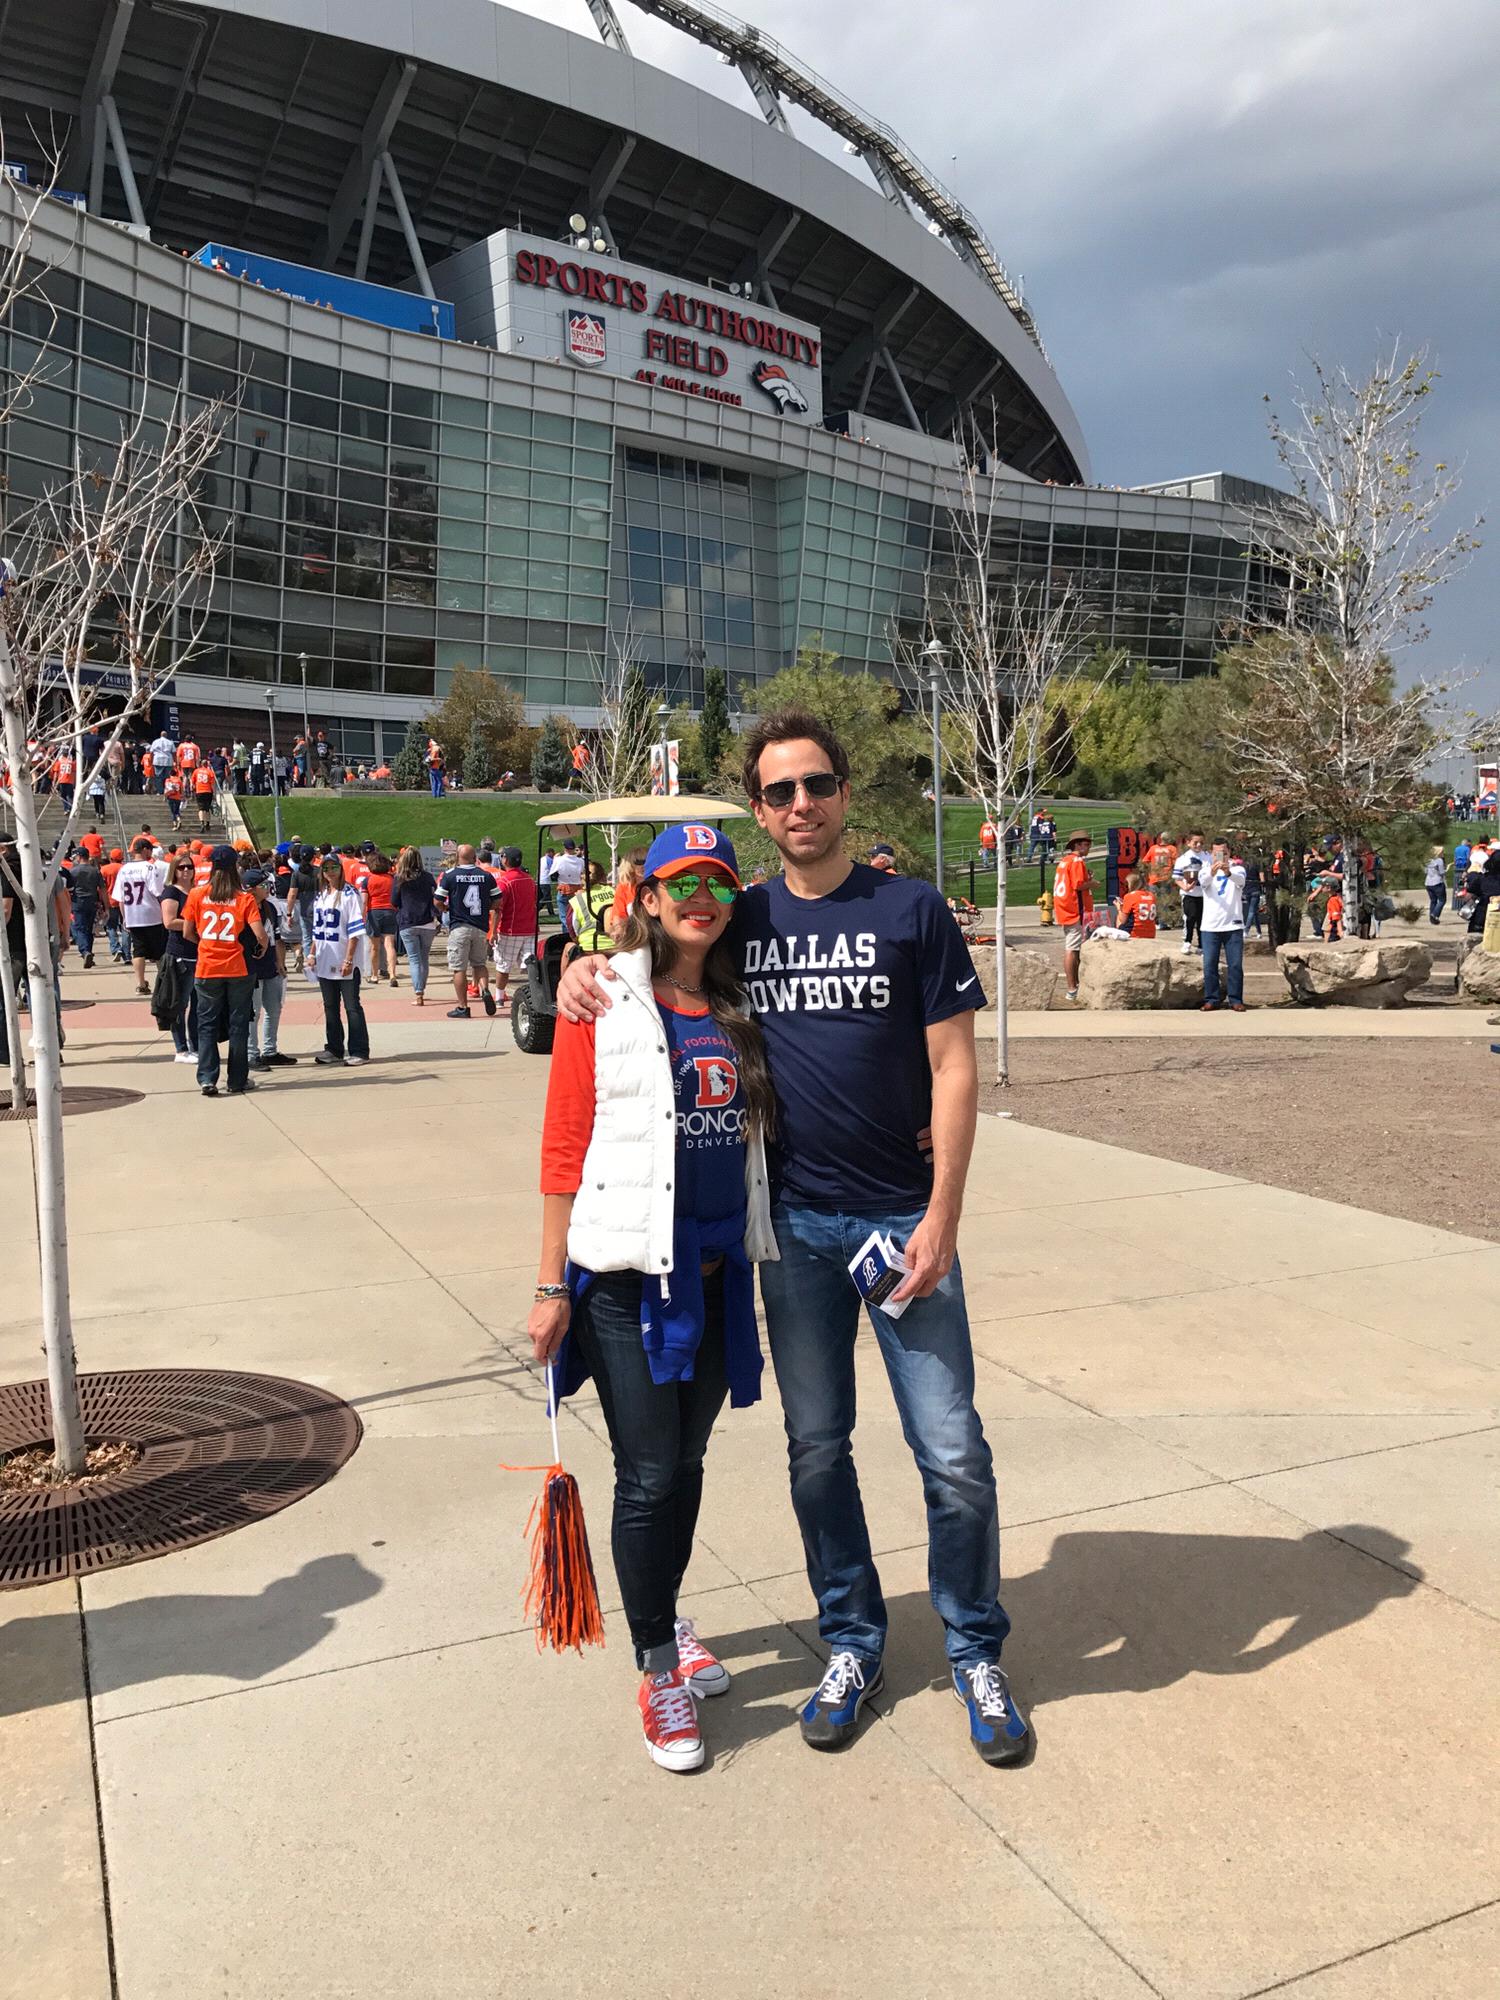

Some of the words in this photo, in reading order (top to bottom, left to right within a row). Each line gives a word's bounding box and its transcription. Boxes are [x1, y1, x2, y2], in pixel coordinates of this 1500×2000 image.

[516, 249, 649, 312] SPORTS
[655, 289, 822, 369] AUTHORITY
[571, 329, 604, 343] SPORTS
[646, 328, 729, 377] FIELD
[636, 369, 657, 384] AT
[661, 375, 701, 395] MILE
[704, 386, 742, 406] HIGH
[456, 875, 485, 883] PRESCOTT
[1216, 875, 1229, 897] 7
[462, 884, 482, 916] 4
[590, 890, 615, 903] rgus
[201, 910, 236, 942] 22
[1138, 903, 1157, 921] 58
[743, 932, 877, 974] DALLAS
[678, 1059, 694, 1077] 1960
[692, 1056, 738, 1108] D
[675, 1108, 748, 1136] RONCO
[686, 1135, 742, 1149] DENVER
